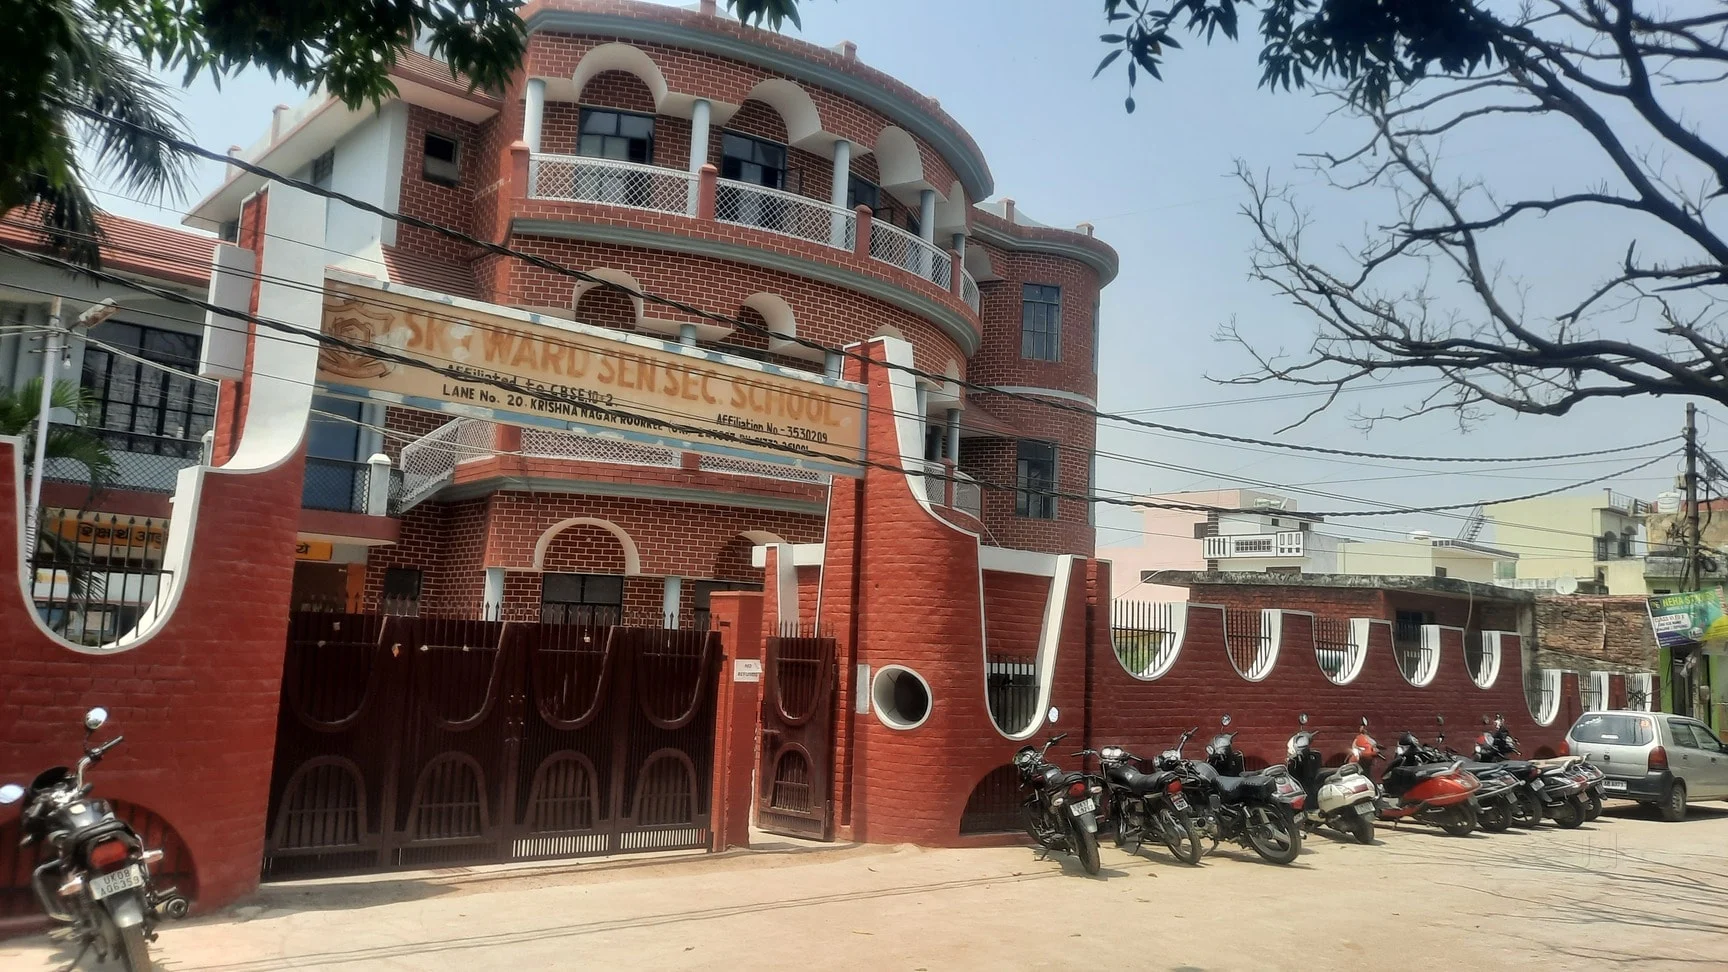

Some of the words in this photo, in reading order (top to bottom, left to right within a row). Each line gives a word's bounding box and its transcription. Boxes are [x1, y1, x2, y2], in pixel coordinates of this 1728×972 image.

[443, 384, 475, 400] LANE
[531, 398, 578, 417] KRISHNA
[580, 408, 618, 424] NAGAR
[1662, 597, 1685, 608] NEHA
